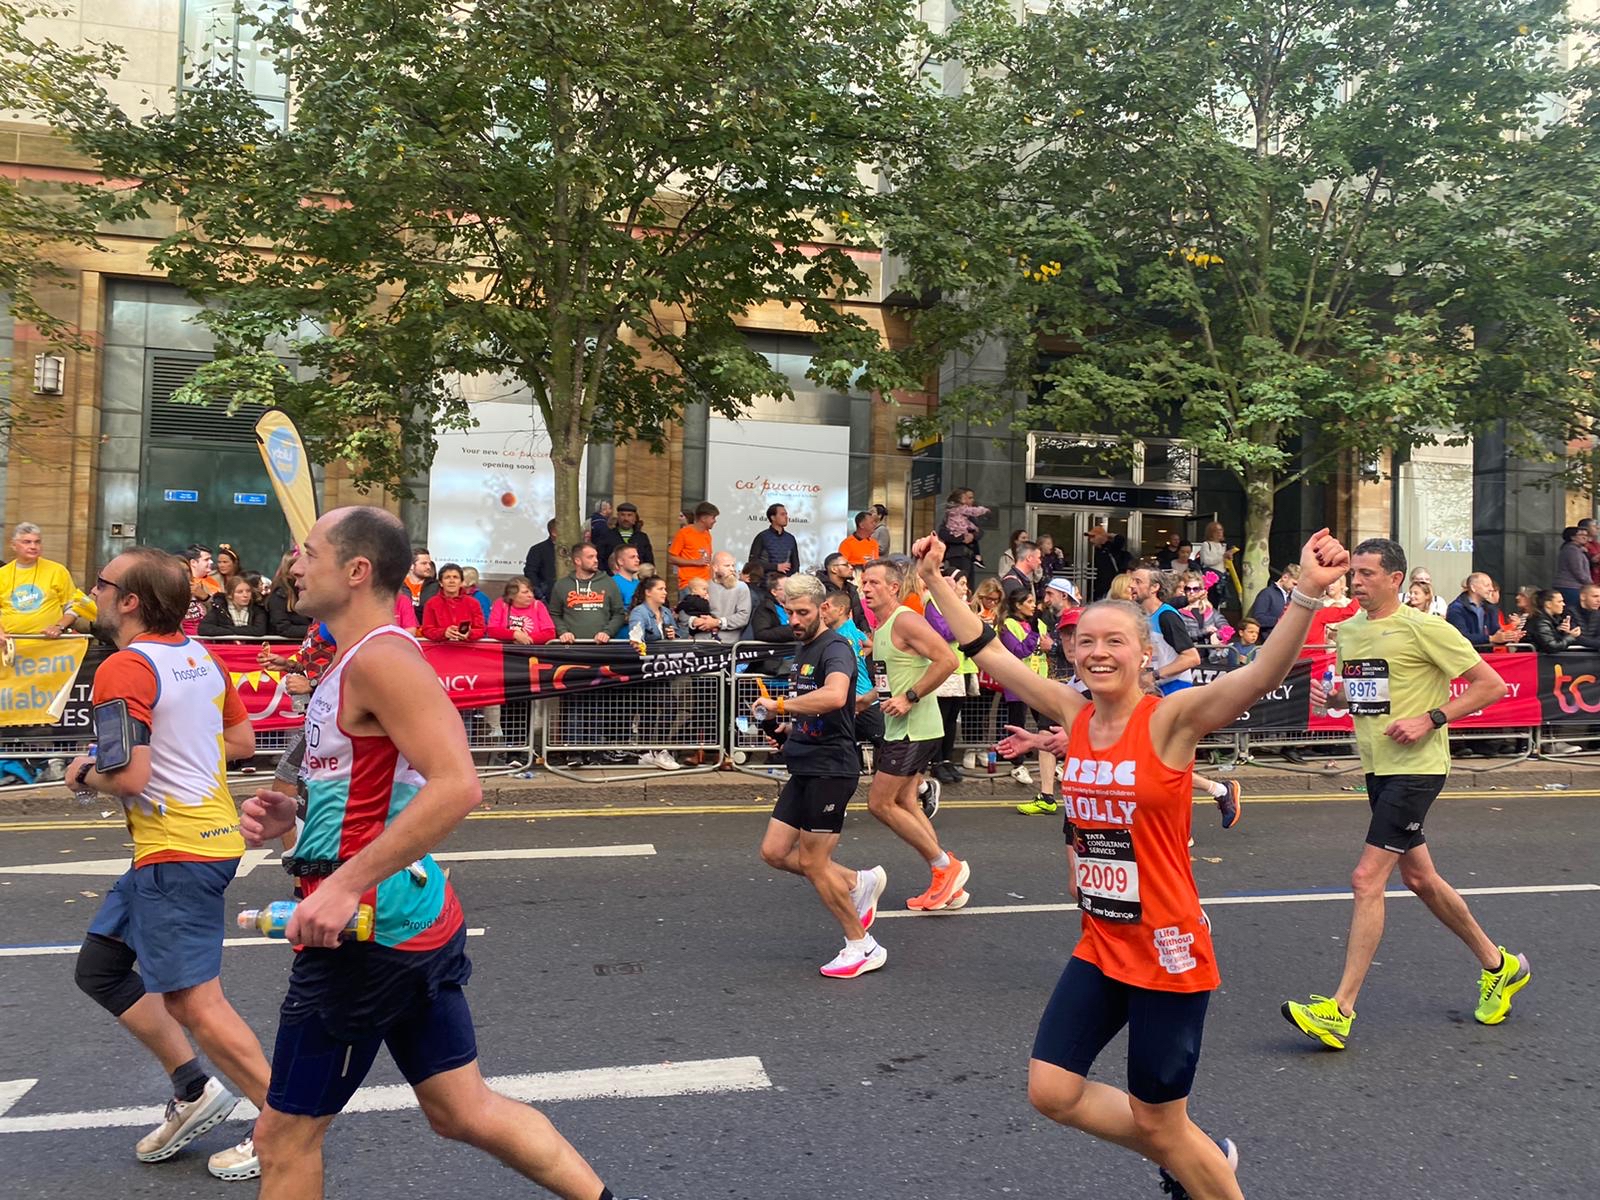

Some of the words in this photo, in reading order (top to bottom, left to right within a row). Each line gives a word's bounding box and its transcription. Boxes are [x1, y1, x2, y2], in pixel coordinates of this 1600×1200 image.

[461, 447, 480, 455] Your
[482, 461, 514, 470] opening
[1043, 487, 1086, 501] CABOT
[1088, 490, 1127, 503] PLACE
[747, 514, 758, 522] All
[1424, 536, 1474, 552] ZAR
[172, 664, 208, 683] hospice
[1349, 681, 1377, 697] 8975
[1553, 664, 1600, 714] tc
[1064, 757, 1136, 785] RSBC
[1109, 789, 1136, 797] Children
[1063, 795, 1137, 825] HOLLY
[1087, 840, 1131, 849] CONSULTANCY
[1088, 847, 1117, 855] SERVICES
[1079, 863, 1128, 893] 2009
[1104, 908, 1134, 919] balance
[401, 919, 433, 930] Proud
[1158, 929, 1176, 938] Life
[1157, 934, 1192, 947] Without
